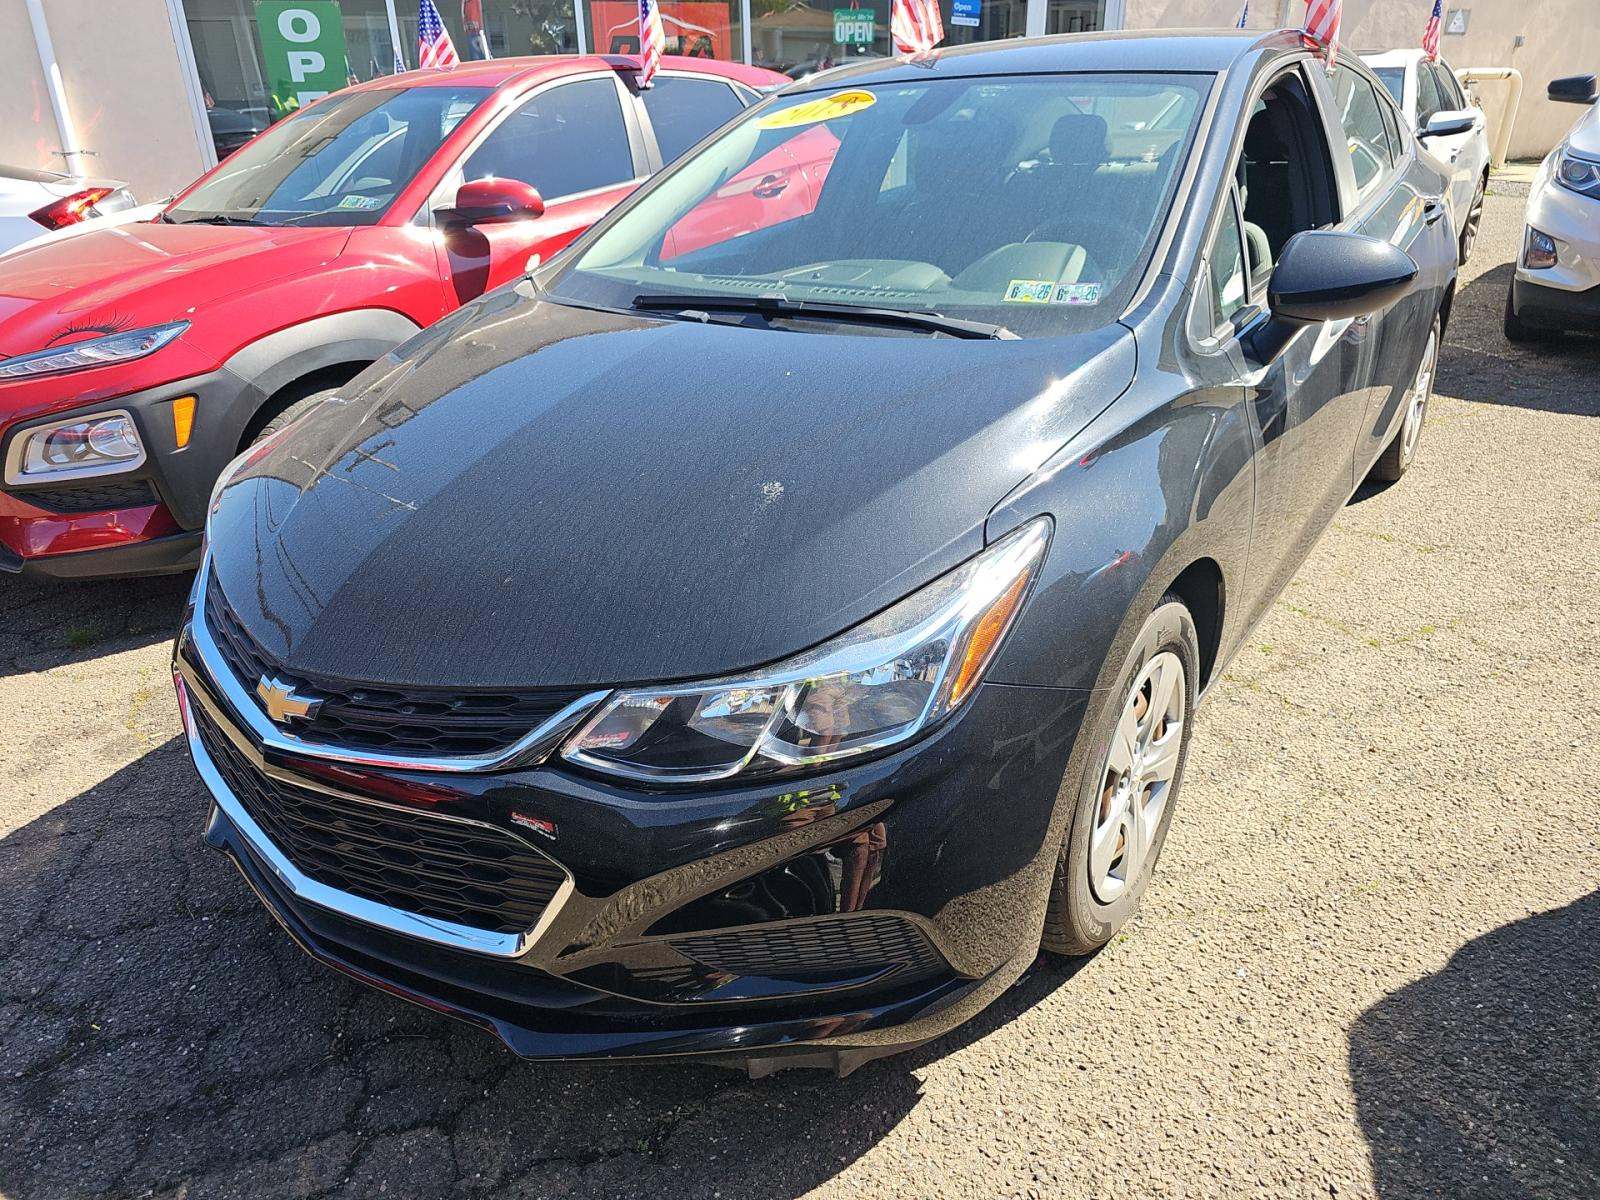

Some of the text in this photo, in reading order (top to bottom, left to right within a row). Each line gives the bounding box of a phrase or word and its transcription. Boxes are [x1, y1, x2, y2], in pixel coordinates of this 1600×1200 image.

[835, 22, 873, 42] OPEN
[1037, 284, 1052, 299] 26
[1085, 286, 1097, 300] 26
